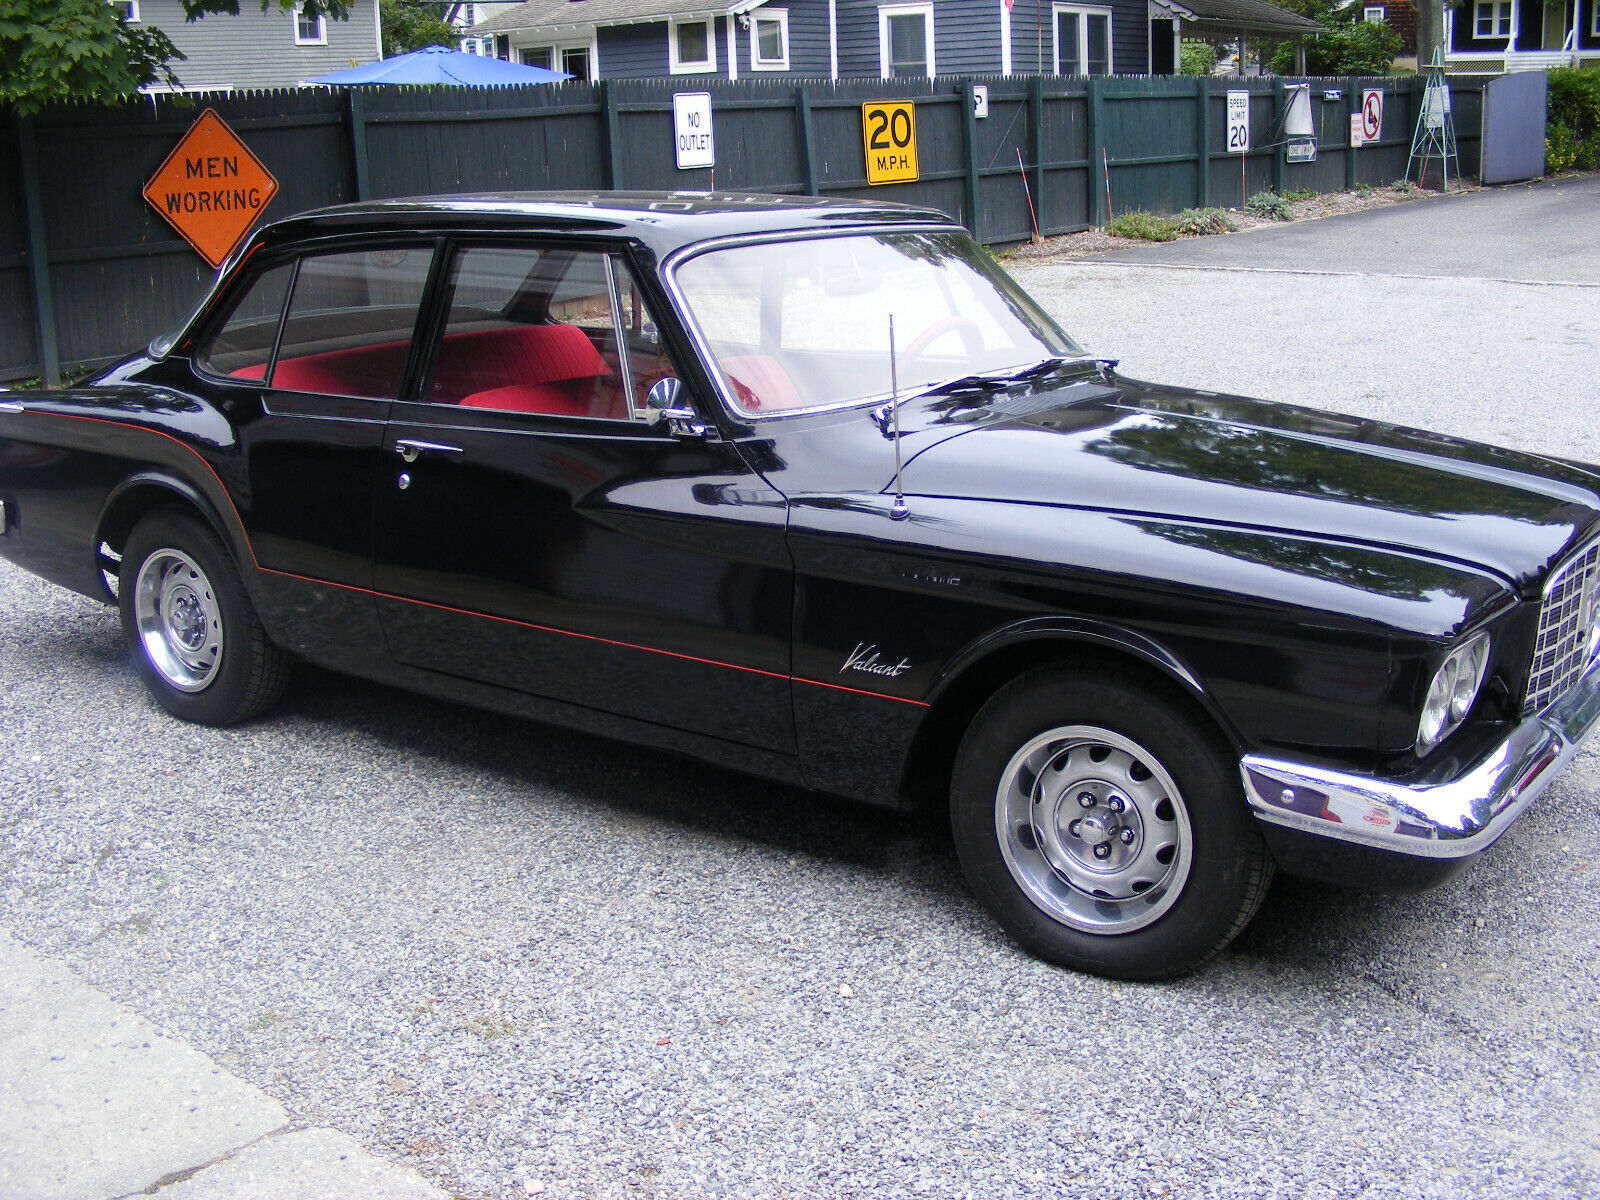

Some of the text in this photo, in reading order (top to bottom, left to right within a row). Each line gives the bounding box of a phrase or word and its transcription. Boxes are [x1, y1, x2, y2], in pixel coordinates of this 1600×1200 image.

[1230, 98, 1247, 108] SPEED
[687, 111, 700, 128] NO
[1231, 111, 1246, 121] LIMIT
[868, 108, 912, 149] 20
[1230, 125, 1247, 148] 20
[679, 134, 710, 152] OUTLET
[185, 156, 238, 179] MEN
[877, 154, 910, 171] M.P.H.
[165, 188, 261, 214] WORKING
[838, 641, 912, 677] Valiant
